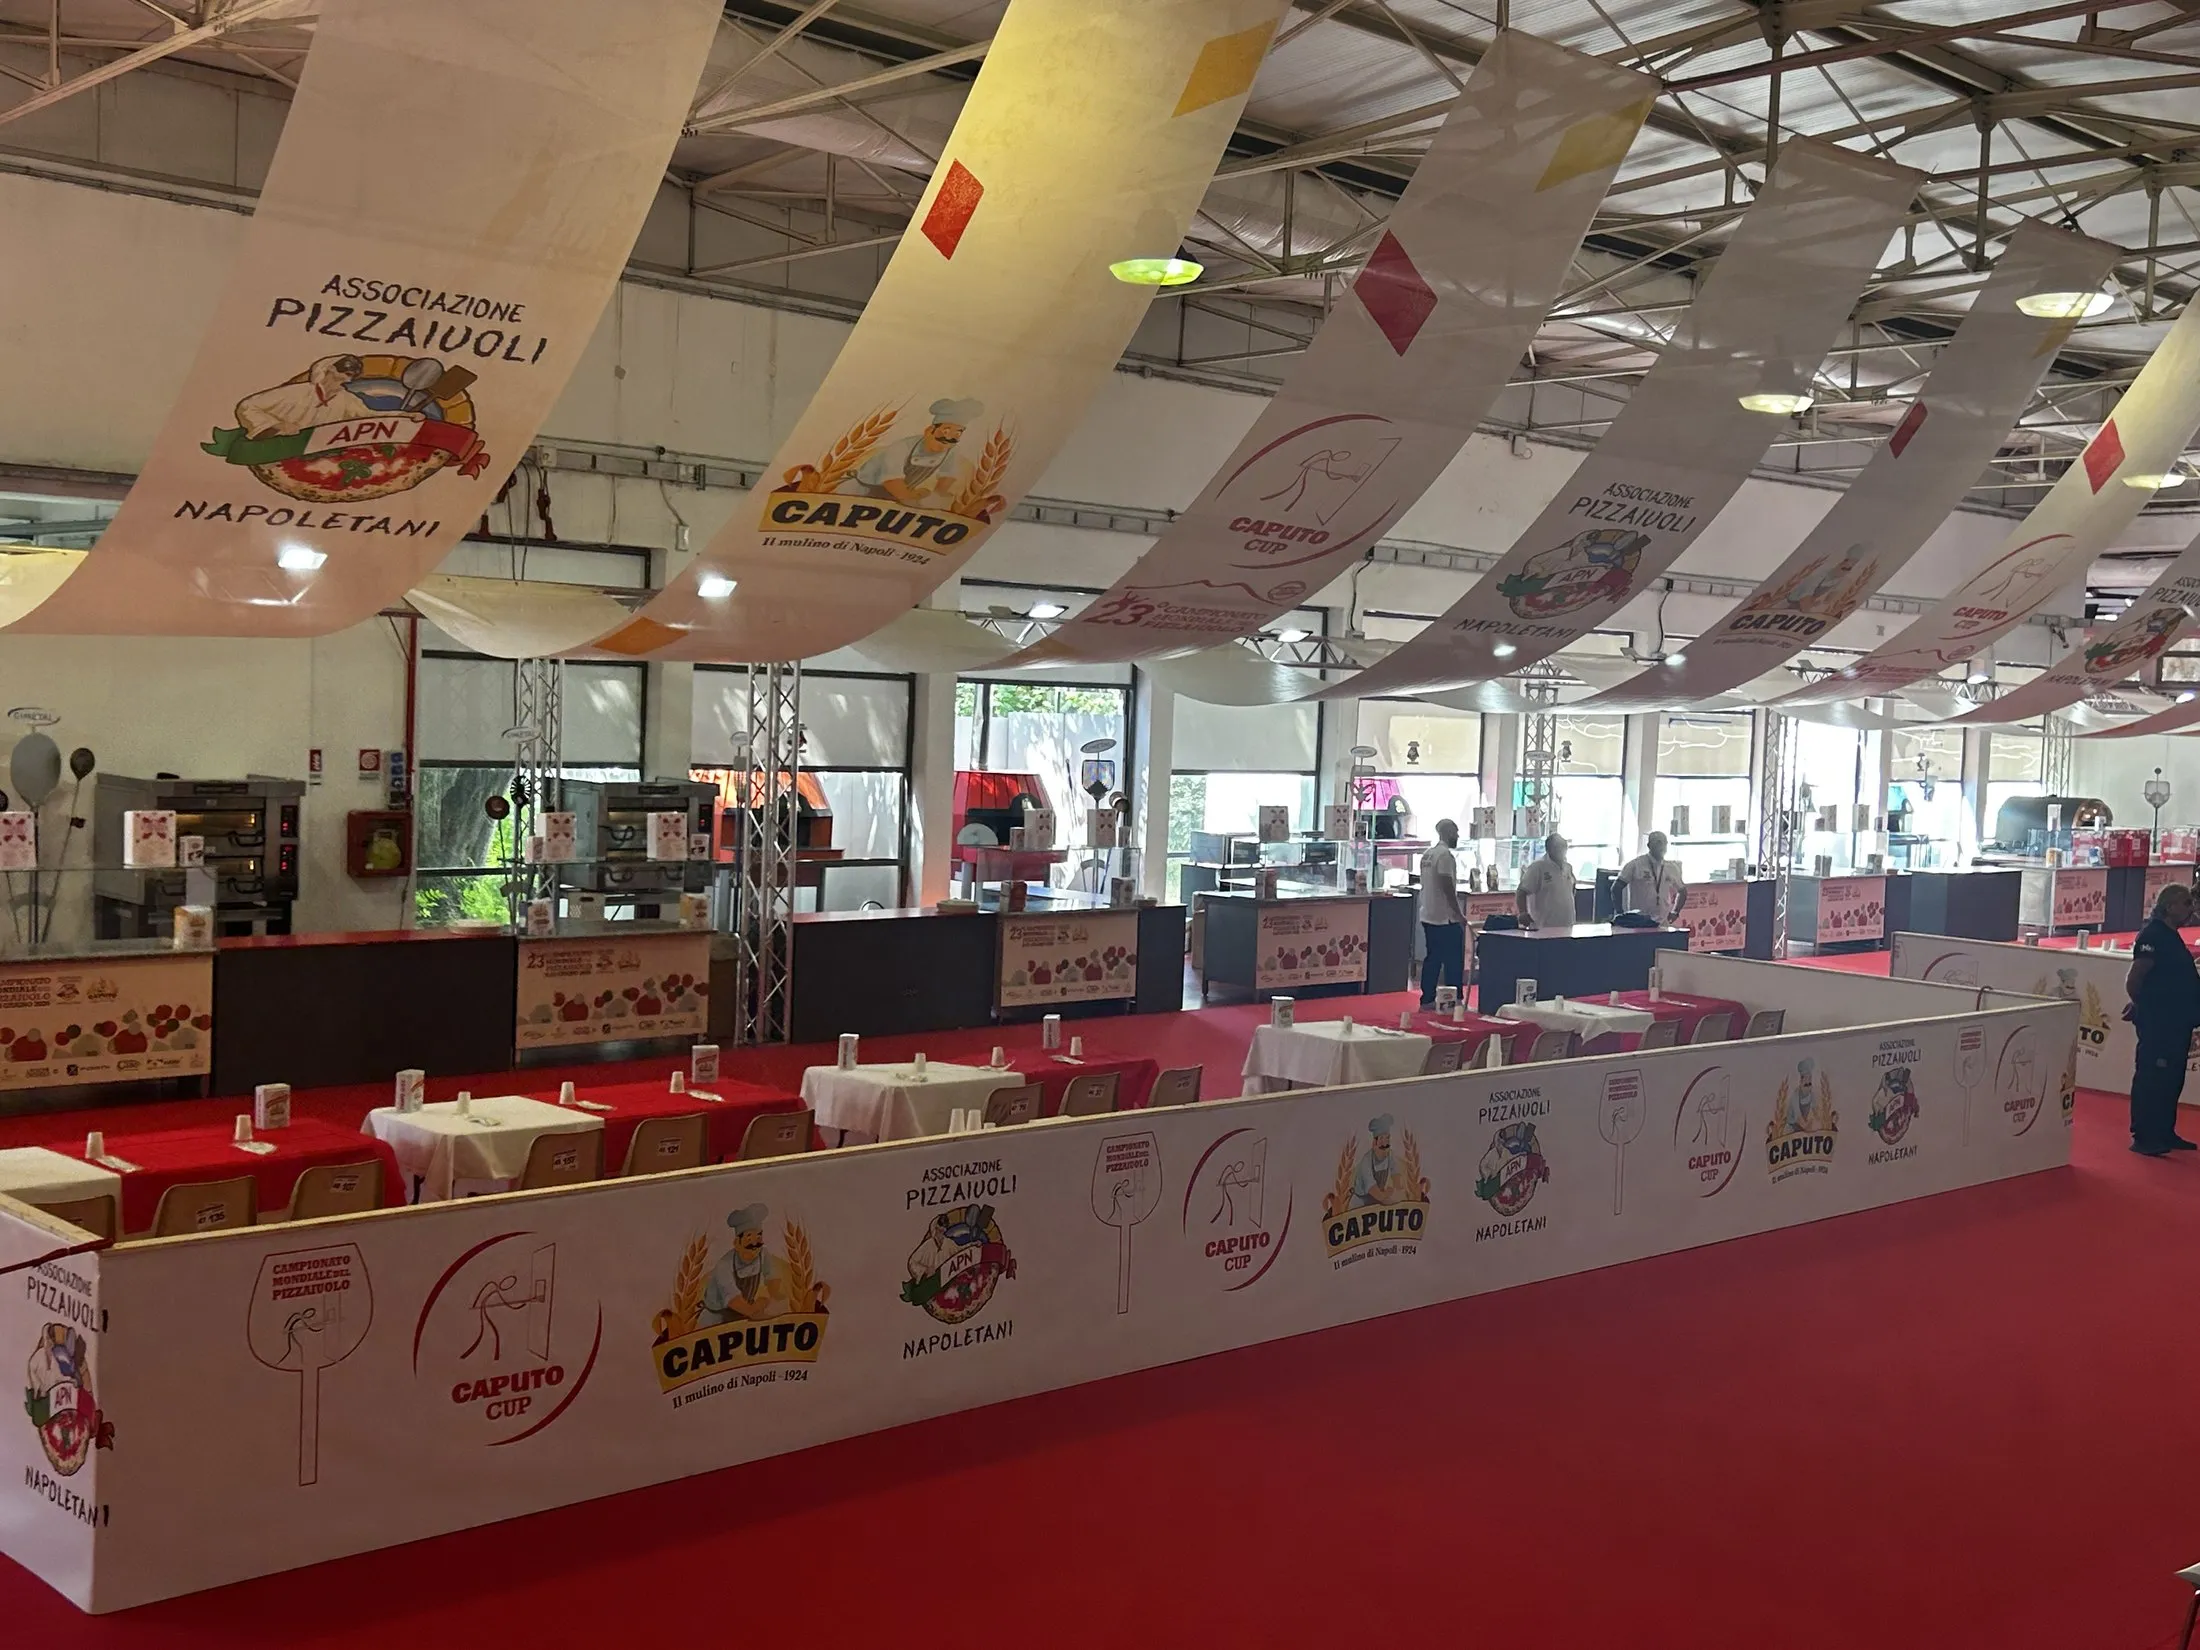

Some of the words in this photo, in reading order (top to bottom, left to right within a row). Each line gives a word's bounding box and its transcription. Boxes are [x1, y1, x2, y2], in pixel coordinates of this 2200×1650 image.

[321, 274, 526, 323] ASSOCIAZIONE
[266, 298, 547, 364] PIZZAIUOLI
[328, 420, 398, 445] APN
[1603, 482, 1696, 509] ASSOCIAZIONE
[174, 500, 440, 538] NAPOLETANI
[771, 500, 969, 545] CAPUTO
[1568, 496, 1697, 533] PIZZAIUOLI
[1228, 517, 1330, 545] CAPUTO
[778, 537, 831, 550] mulino
[833, 539, 850, 551] di
[852, 543, 895, 558] Napoli
[1244, 539, 1289, 555] CUP
[1558, 568, 1598, 583] APN
[1728, 614, 1828, 636] CAPUTO
[1953, 606, 2008, 621] CAPUTO
[1453, 618, 1578, 639] NAPOLETANI
[1489, 1086, 1541, 1103] ASSOCIAZIONE
[2004, 1097, 2036, 1113] CAPUTO
[1478, 1100, 1550, 1124] PIZZAIUOLI
[1688, 1151, 1731, 1170] CAPUTO
[1769, 1135, 1834, 1165] CAPUTO
[922, 1160, 1003, 1183] ASSOCIAZIONE
[1505, 1158, 1522, 1179] APN
[1700, 1169, 1719, 1181] CUP
[906, 1174, 1018, 1210] PIZZAIUOLI
[1328, 1208, 1424, 1247] CAPUTO
[1475, 1216, 1547, 1242] NAPOLETANI
[1205, 1231, 1271, 1257] CAPUTO
[272, 1255, 351, 1275] CAMPIONATO
[948, 1251, 974, 1278] APN
[1224, 1254, 1251, 1272] CUP
[272, 1271, 333, 1288] MONDIALE
[272, 1280, 351, 1300] PIZZAIUOLO
[27, 1276, 108, 1333] PIZZAIUOLI
[663, 1322, 819, 1378] CAPUTO
[902, 1320, 1013, 1360] NAPOLETANI
[452, 1366, 564, 1403] CAPUTO
[672, 1395, 682, 1409] Il
[684, 1383, 725, 1405] mulino
[727, 1376, 738, 1390] di
[741, 1370, 776, 1387] Napoli
[784, 1370, 808, 1382] 1924
[54, 1387, 72, 1409] APN
[486, 1396, 532, 1420] CUP
[25, 1465, 110, 1529] NAPOLETANI
